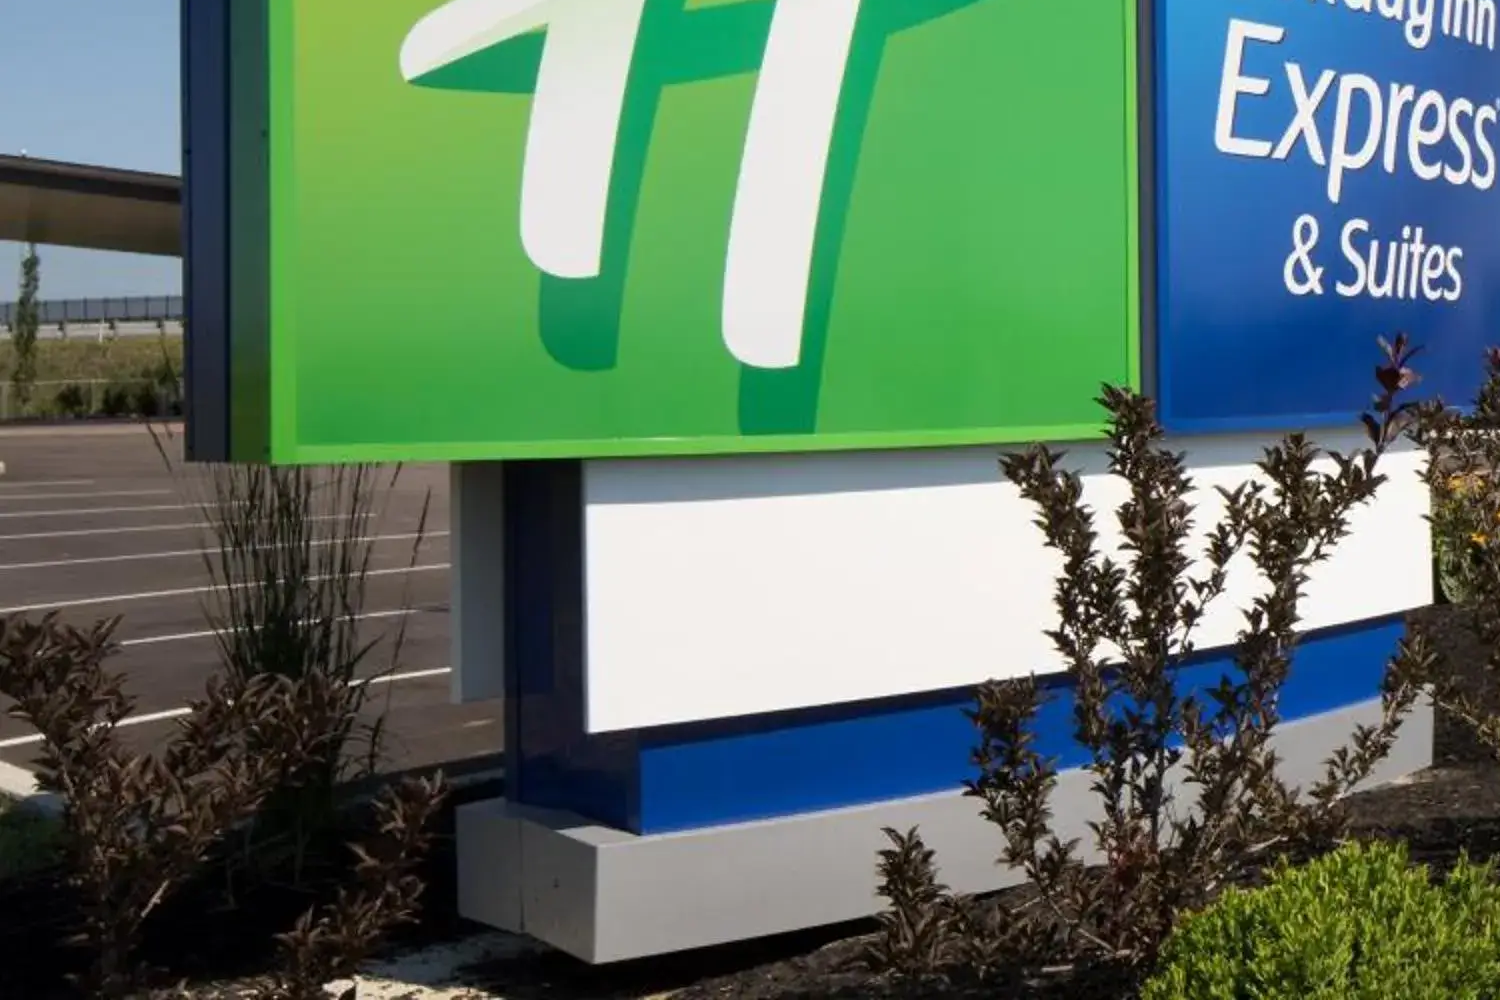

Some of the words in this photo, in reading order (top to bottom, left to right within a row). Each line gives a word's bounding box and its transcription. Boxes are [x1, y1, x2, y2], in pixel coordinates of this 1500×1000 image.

[1213, 18, 1498, 204] Express
[1283, 213, 1324, 296] &
[1335, 218, 1463, 301] Suites
